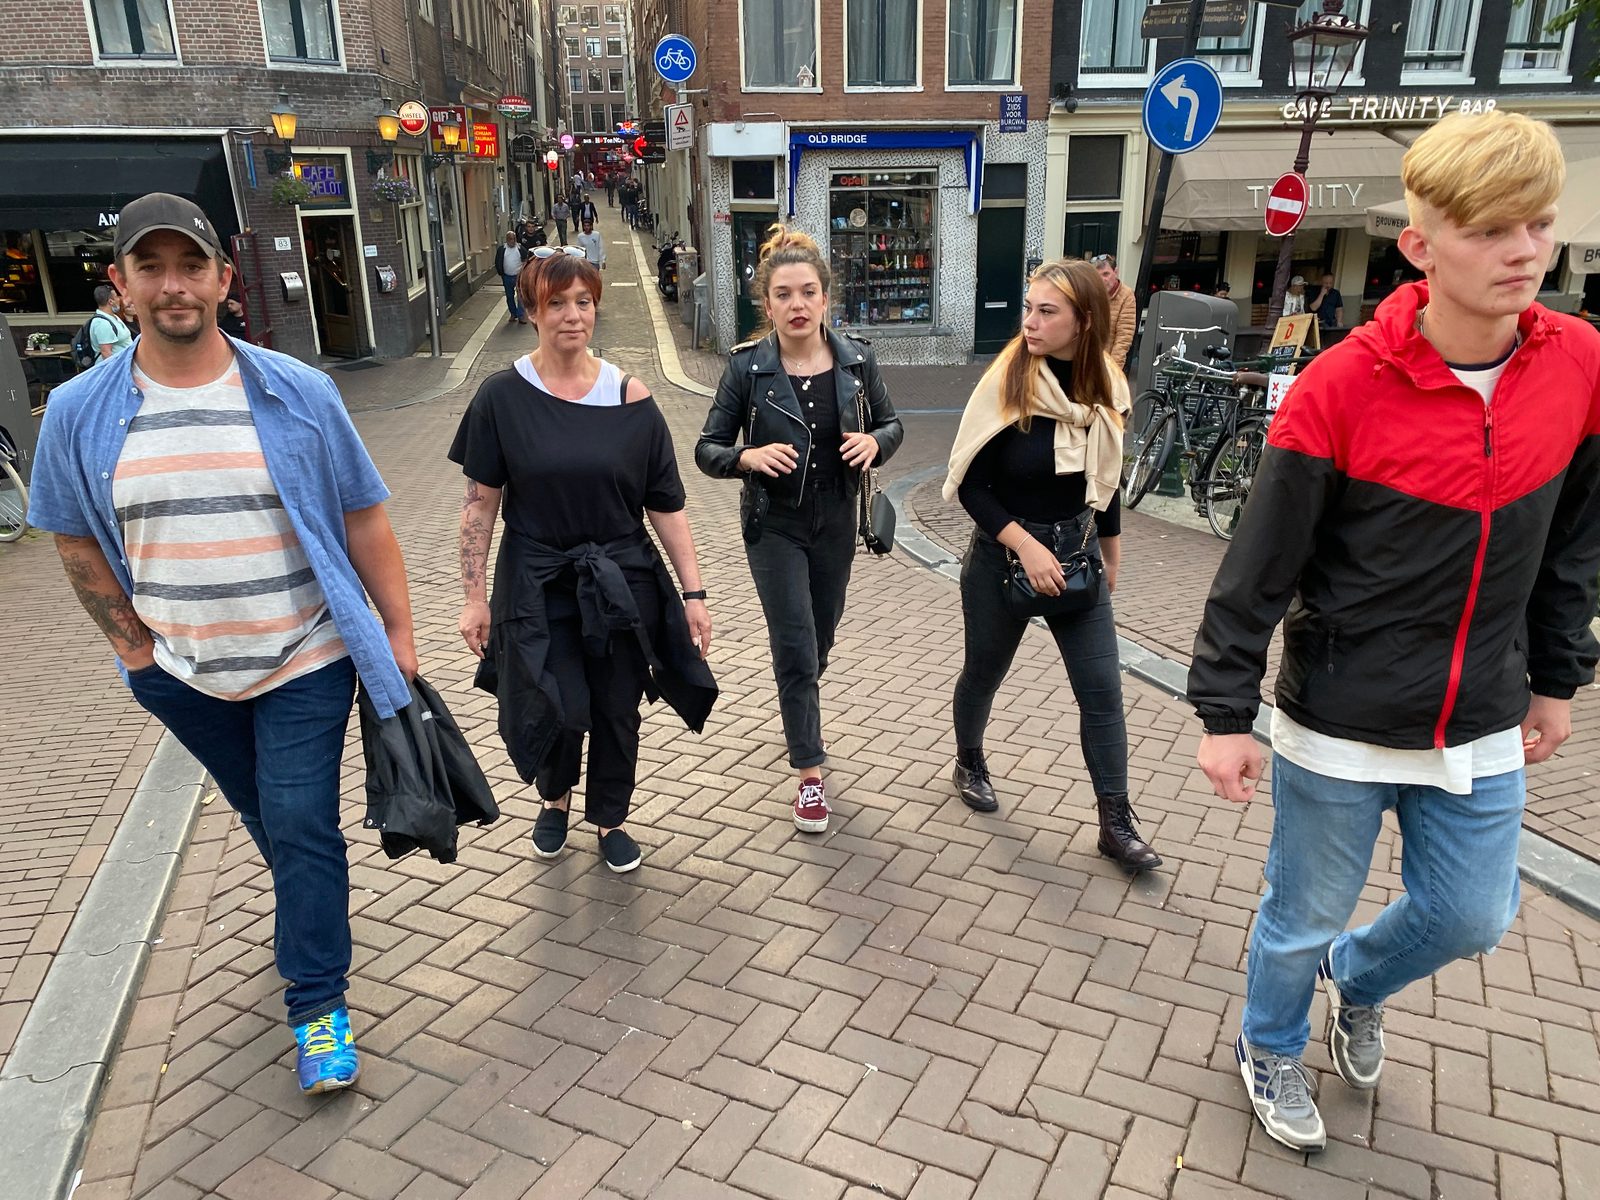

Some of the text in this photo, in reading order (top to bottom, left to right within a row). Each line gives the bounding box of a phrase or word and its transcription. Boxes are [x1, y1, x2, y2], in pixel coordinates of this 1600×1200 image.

[1348, 96, 1453, 119] TRINITY
[1460, 99, 1496, 115] BAR
[808, 135, 867, 143] OLD BRIDGE
[840, 176, 866, 186] Open
